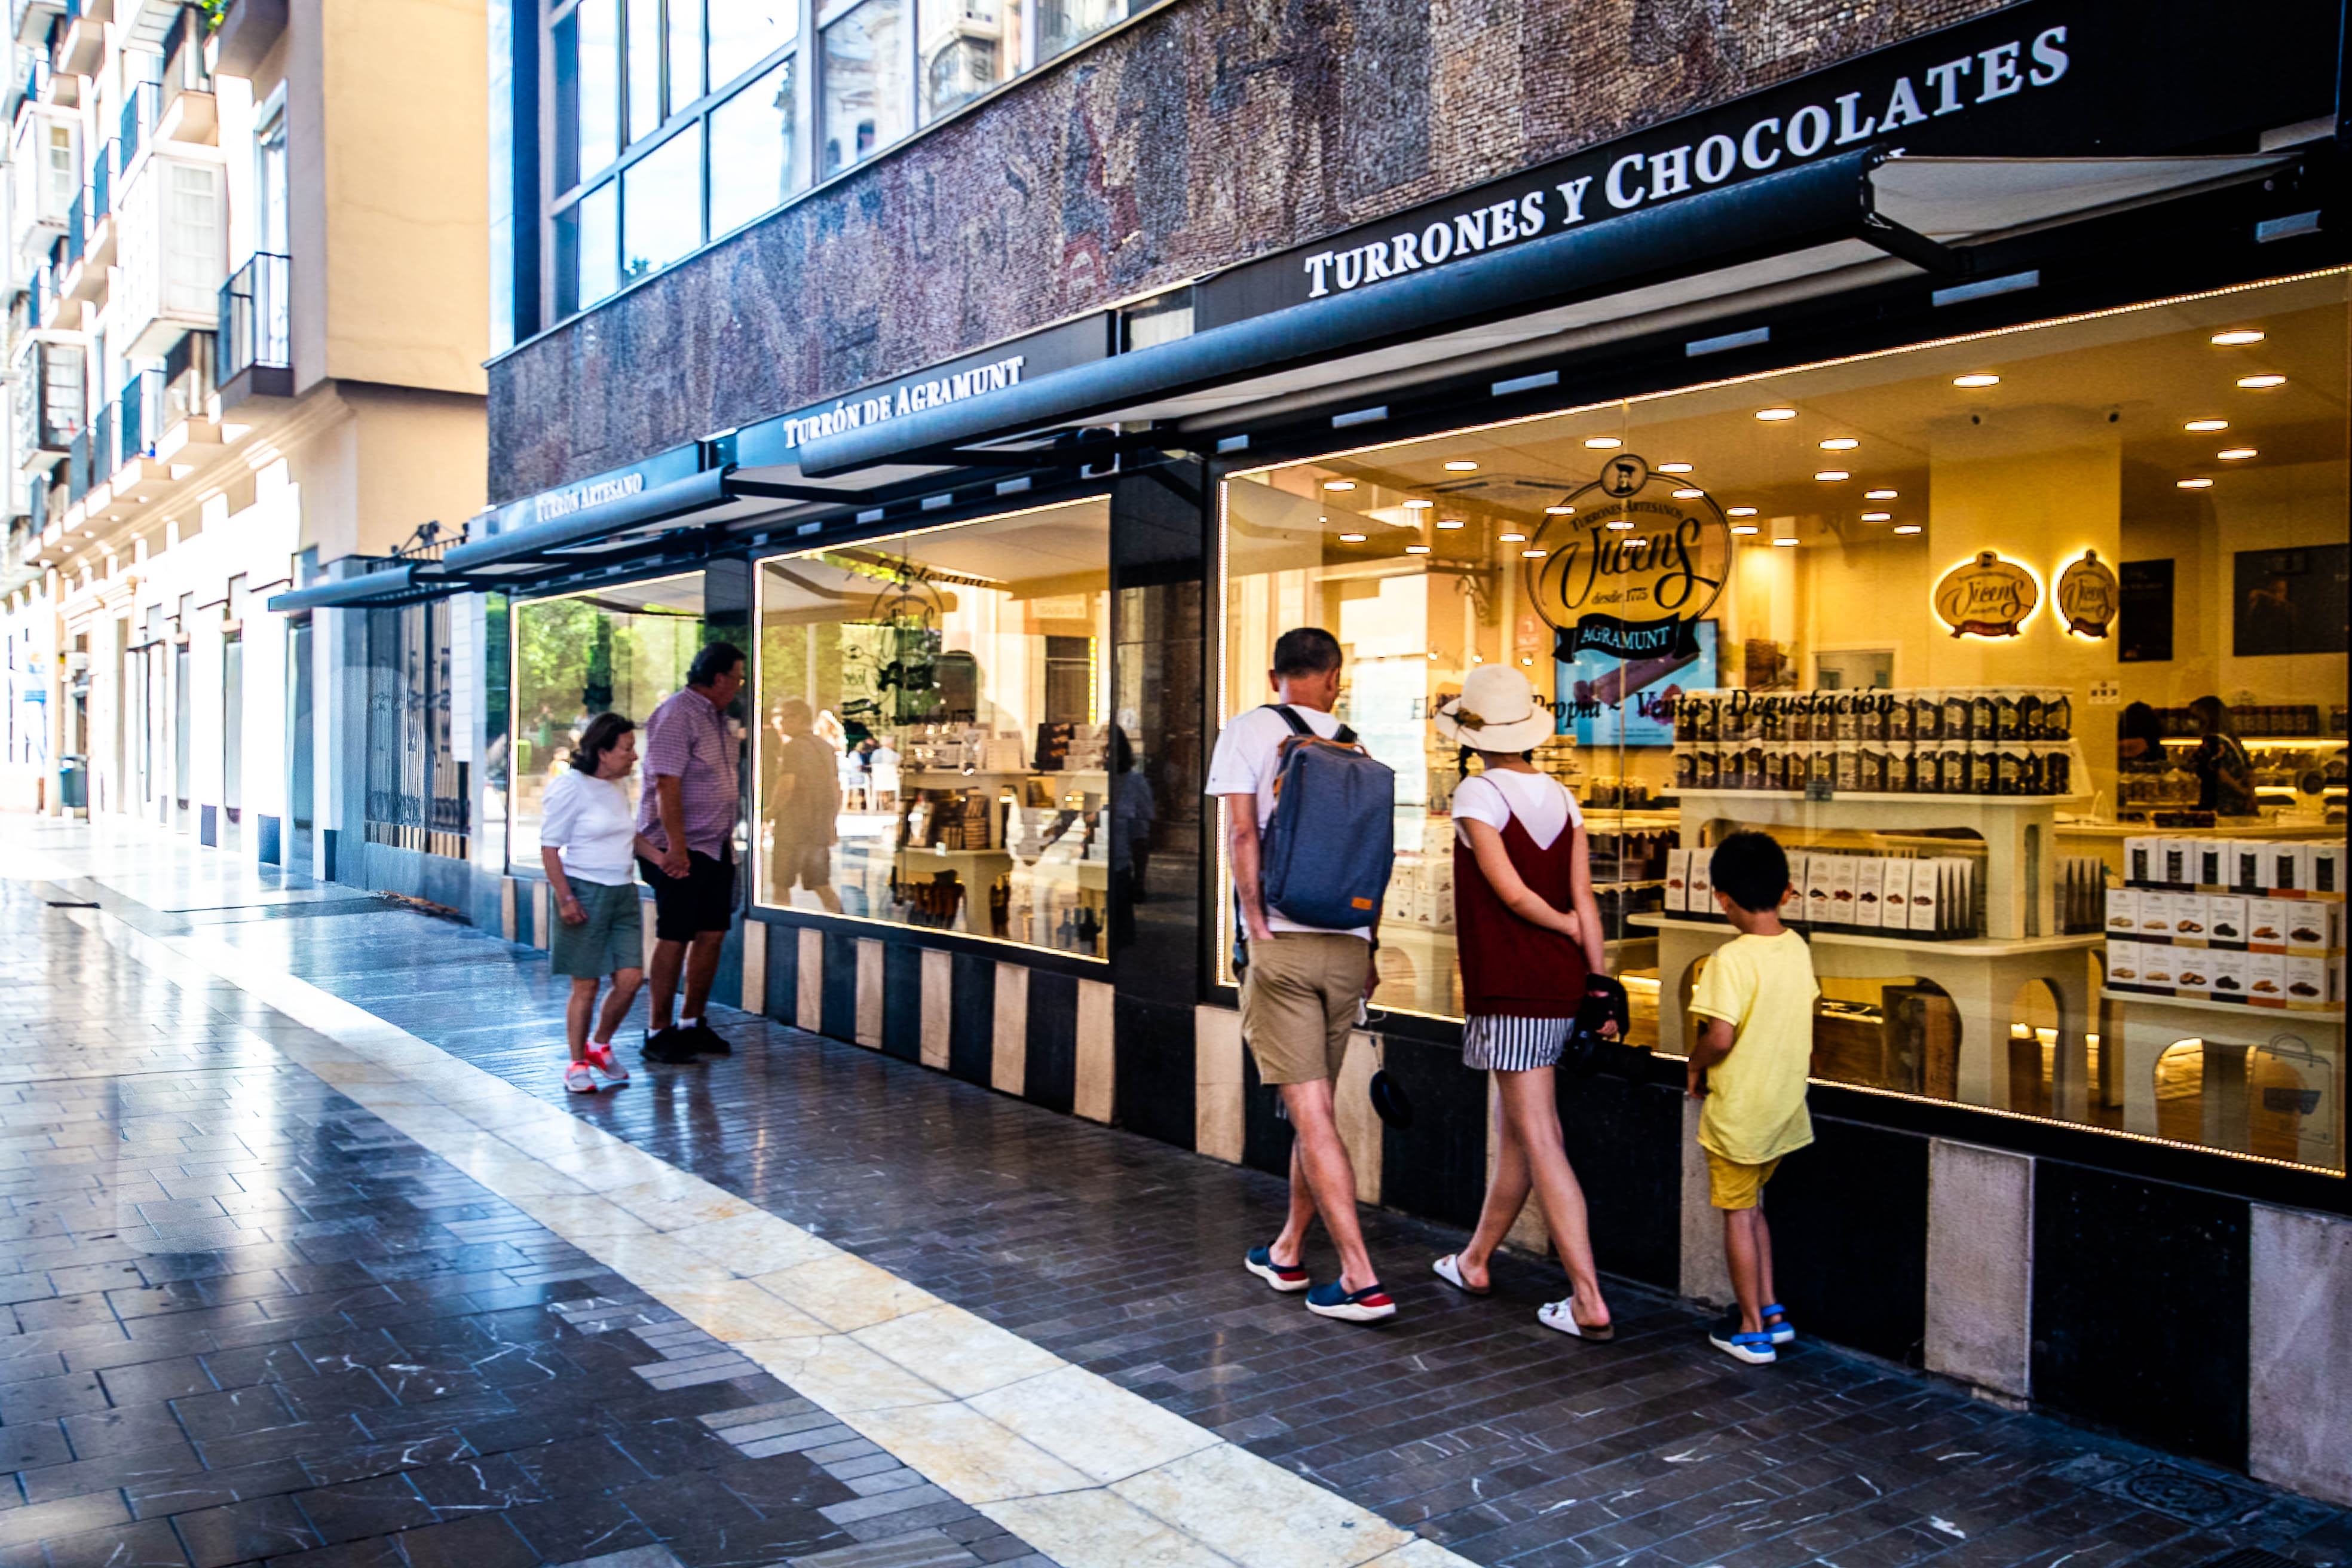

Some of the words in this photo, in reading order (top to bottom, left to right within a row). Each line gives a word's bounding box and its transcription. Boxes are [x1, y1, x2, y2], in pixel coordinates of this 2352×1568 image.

[1304, 191, 1545, 298] TURRONES
[1557, 175, 1593, 225] Y
[1606, 26, 2070, 210] CHOCOLATES
[783, 400, 863, 449] TURRÓN
[863, 395, 893, 424] DE
[895, 356, 1025, 416] AGRAMUNT
[1579, 624, 1672, 649] AGRAMUNT
[1636, 690, 1701, 718] Venta
[1729, 684, 1895, 727] Degustación
